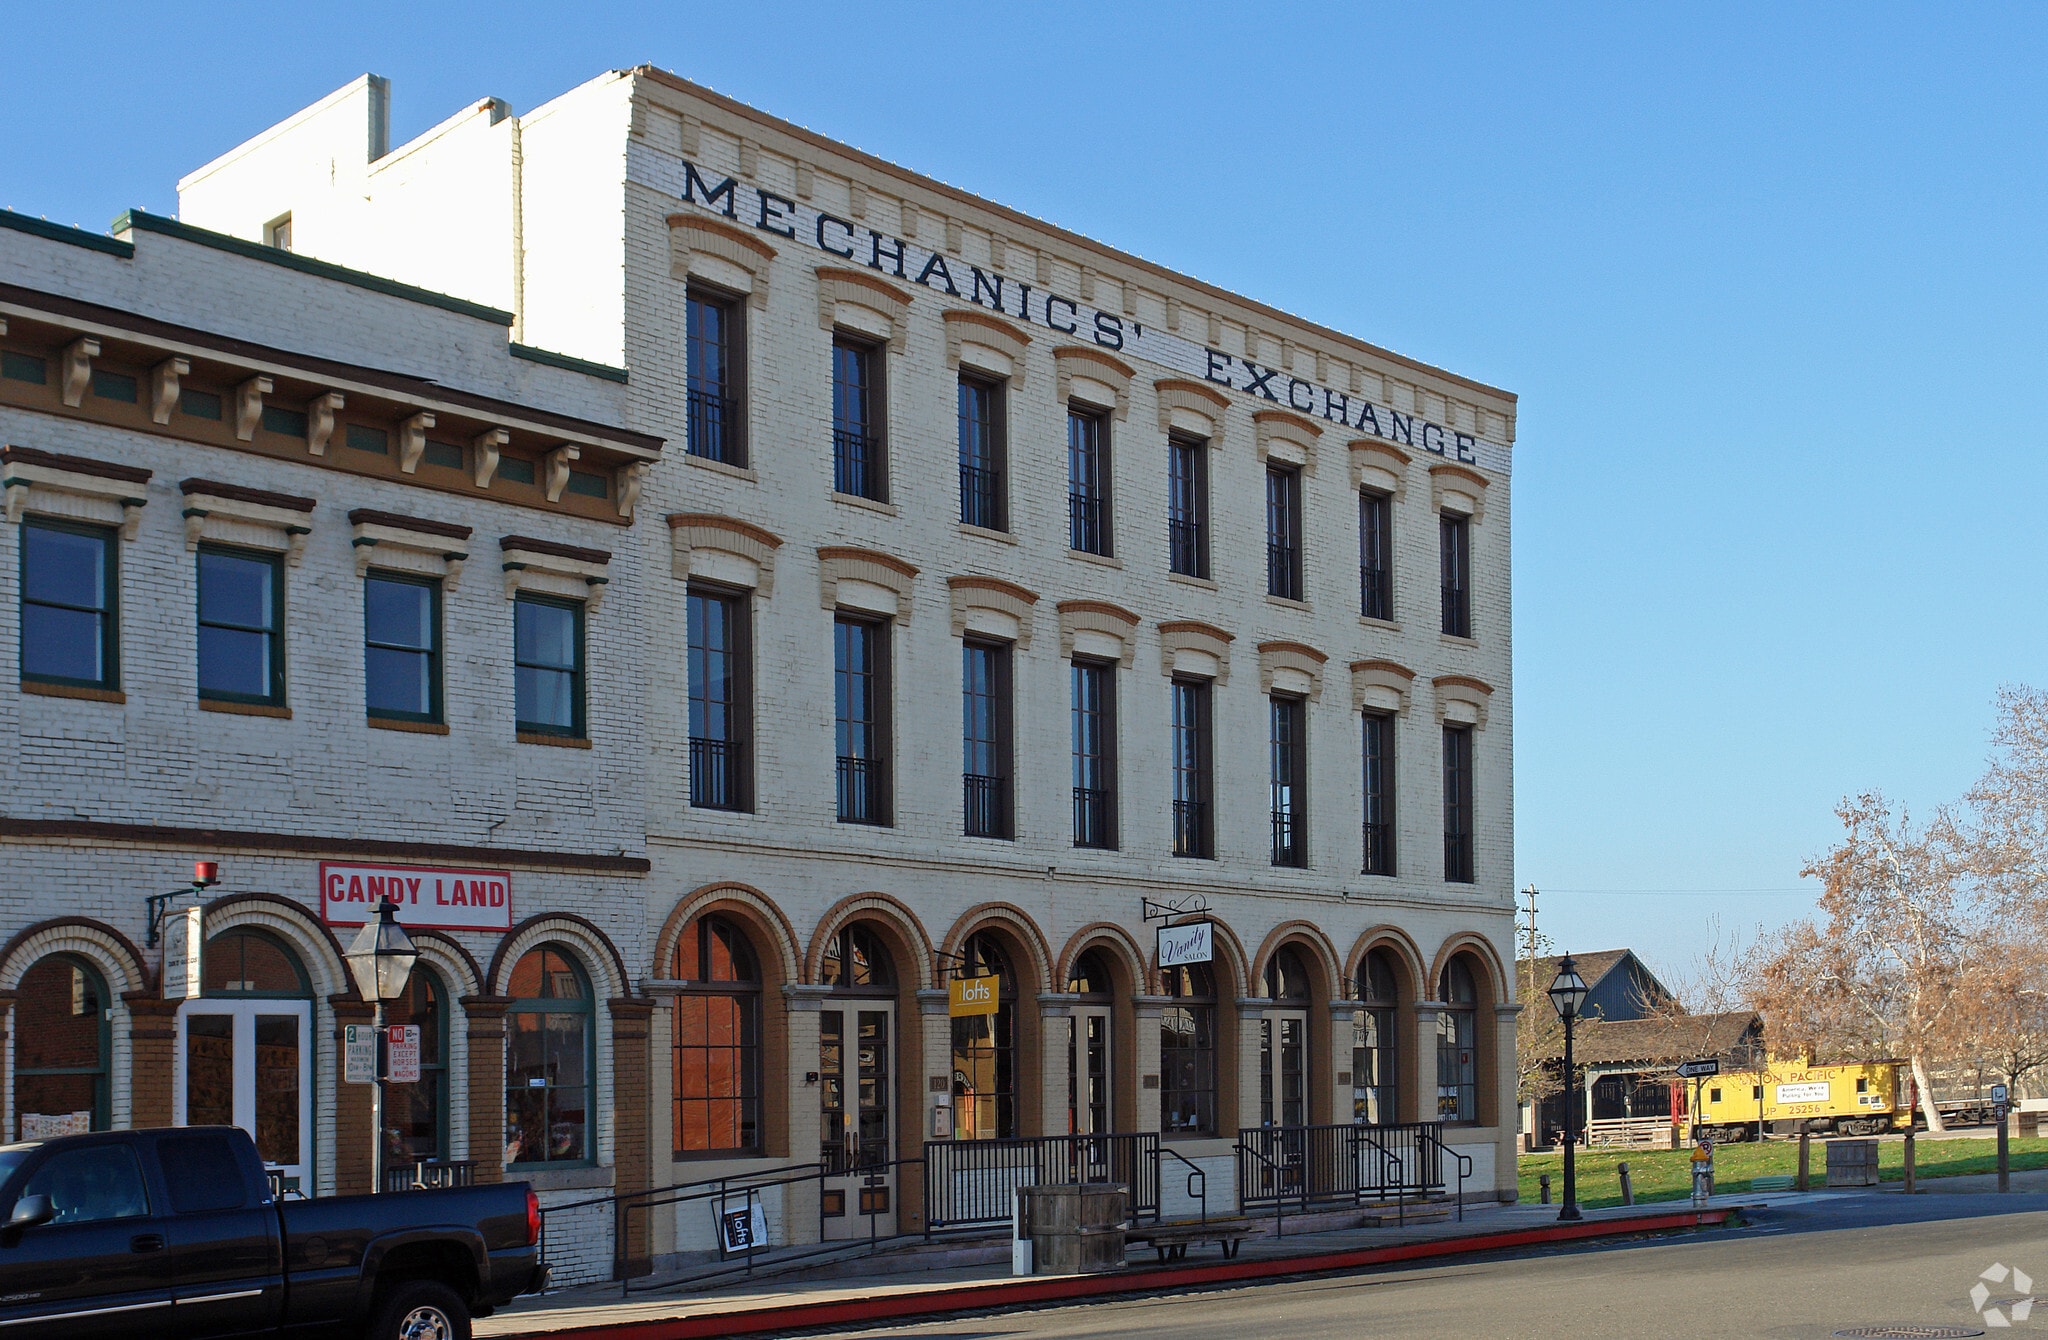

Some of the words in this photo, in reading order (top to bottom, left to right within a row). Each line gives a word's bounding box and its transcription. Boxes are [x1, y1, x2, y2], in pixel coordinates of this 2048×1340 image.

[681, 160, 1142, 351] MECHANICS'
[1205, 346, 1476, 466] EXCHANGE
[327, 873, 422, 905] CANDY
[435, 878, 504, 907] LAND
[1161, 925, 1205, 963] Vanity
[1184, 951, 1208, 961] SALON
[348, 1028, 355, 1041] 2
[392, 1028, 403, 1041] NO
[348, 1045, 372, 1056] PARKING
[1790, 1070, 1836, 1082] PACIFIC
[933, 1078, 945, 1089] 120
[1788, 1104, 1821, 1115] 25256
